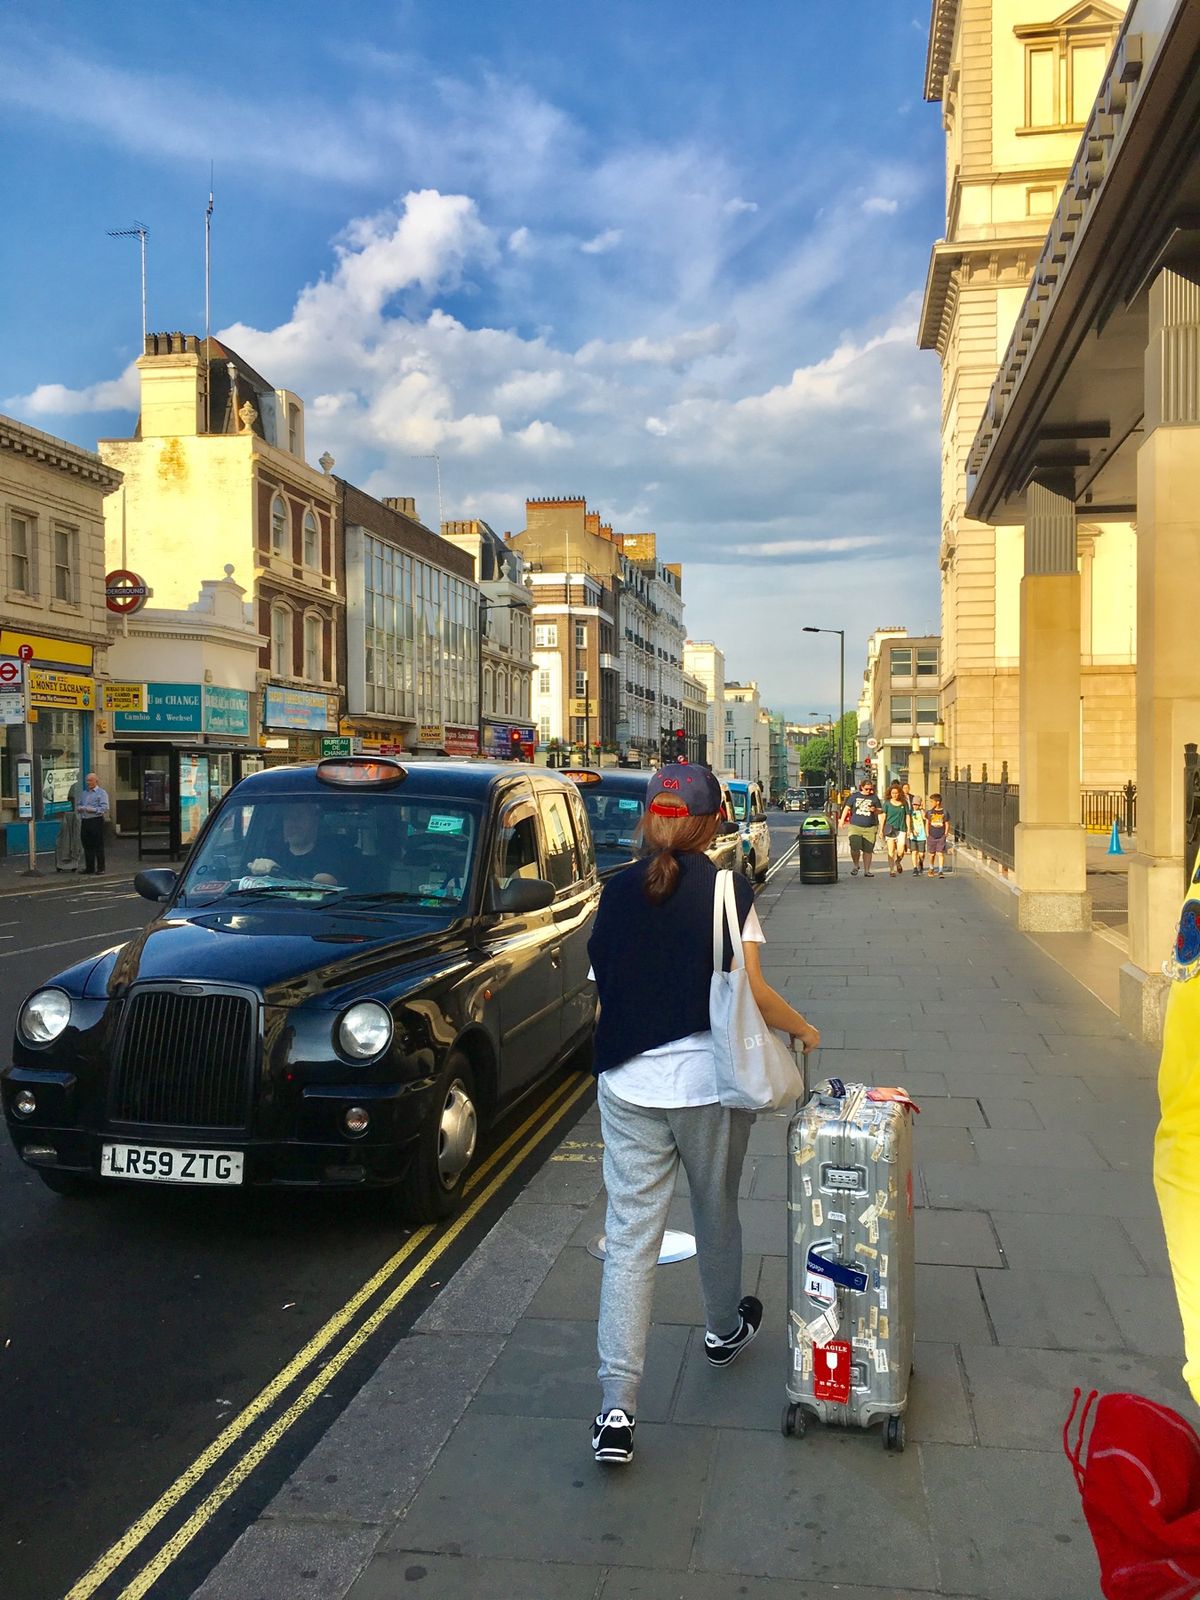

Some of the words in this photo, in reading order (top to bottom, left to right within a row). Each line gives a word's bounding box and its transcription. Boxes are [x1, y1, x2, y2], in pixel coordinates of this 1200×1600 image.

[21, 647, 29, 659] F
[36, 680, 58, 691] MONEY
[59, 682, 91, 694] EXCHANGE
[165, 694, 200, 706] CHANGE
[124, 713, 150, 721] Cambio
[166, 714, 193, 722] Wechsel
[110, 1147, 174, 1176] LR59
[180, 1153, 232, 1180] ZTG
